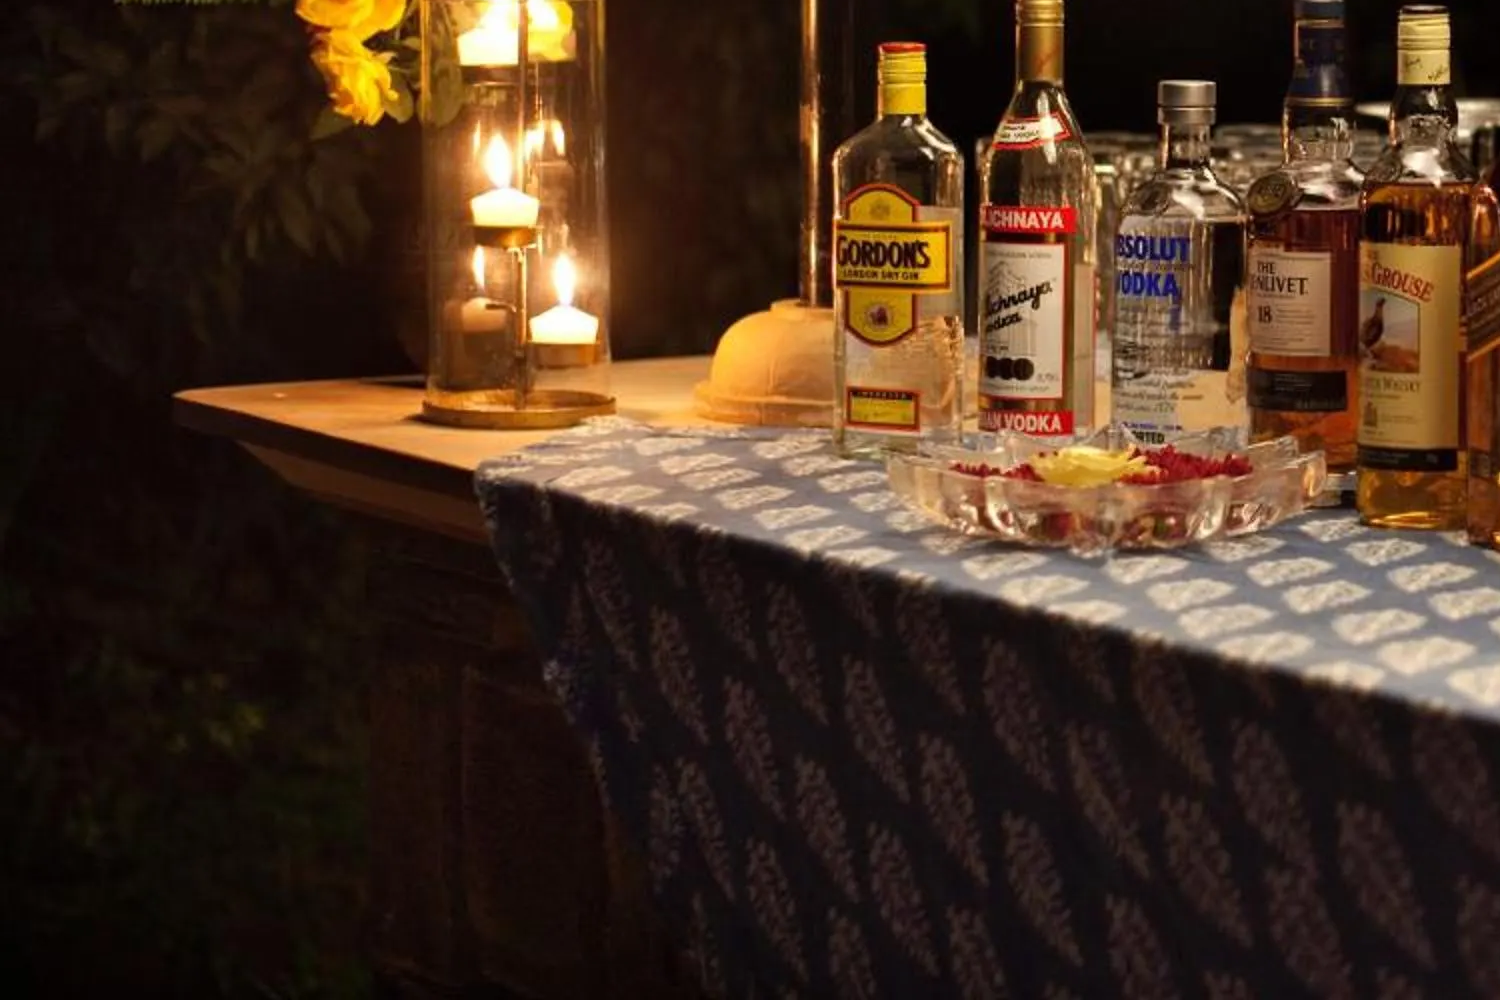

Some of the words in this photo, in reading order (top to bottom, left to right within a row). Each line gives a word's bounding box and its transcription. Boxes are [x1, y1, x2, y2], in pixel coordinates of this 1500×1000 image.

[837, 235, 931, 268] GORDON'S
[1115, 235, 1190, 263] BSOLUT
[881, 270, 900, 281] DRY
[903, 271, 919, 281] GIN
[1257, 261, 1276, 274] THE
[1372, 262, 1435, 303] GROUSE
[1258, 305, 1273, 324] 18
[1003, 411, 1063, 433] VODKA
